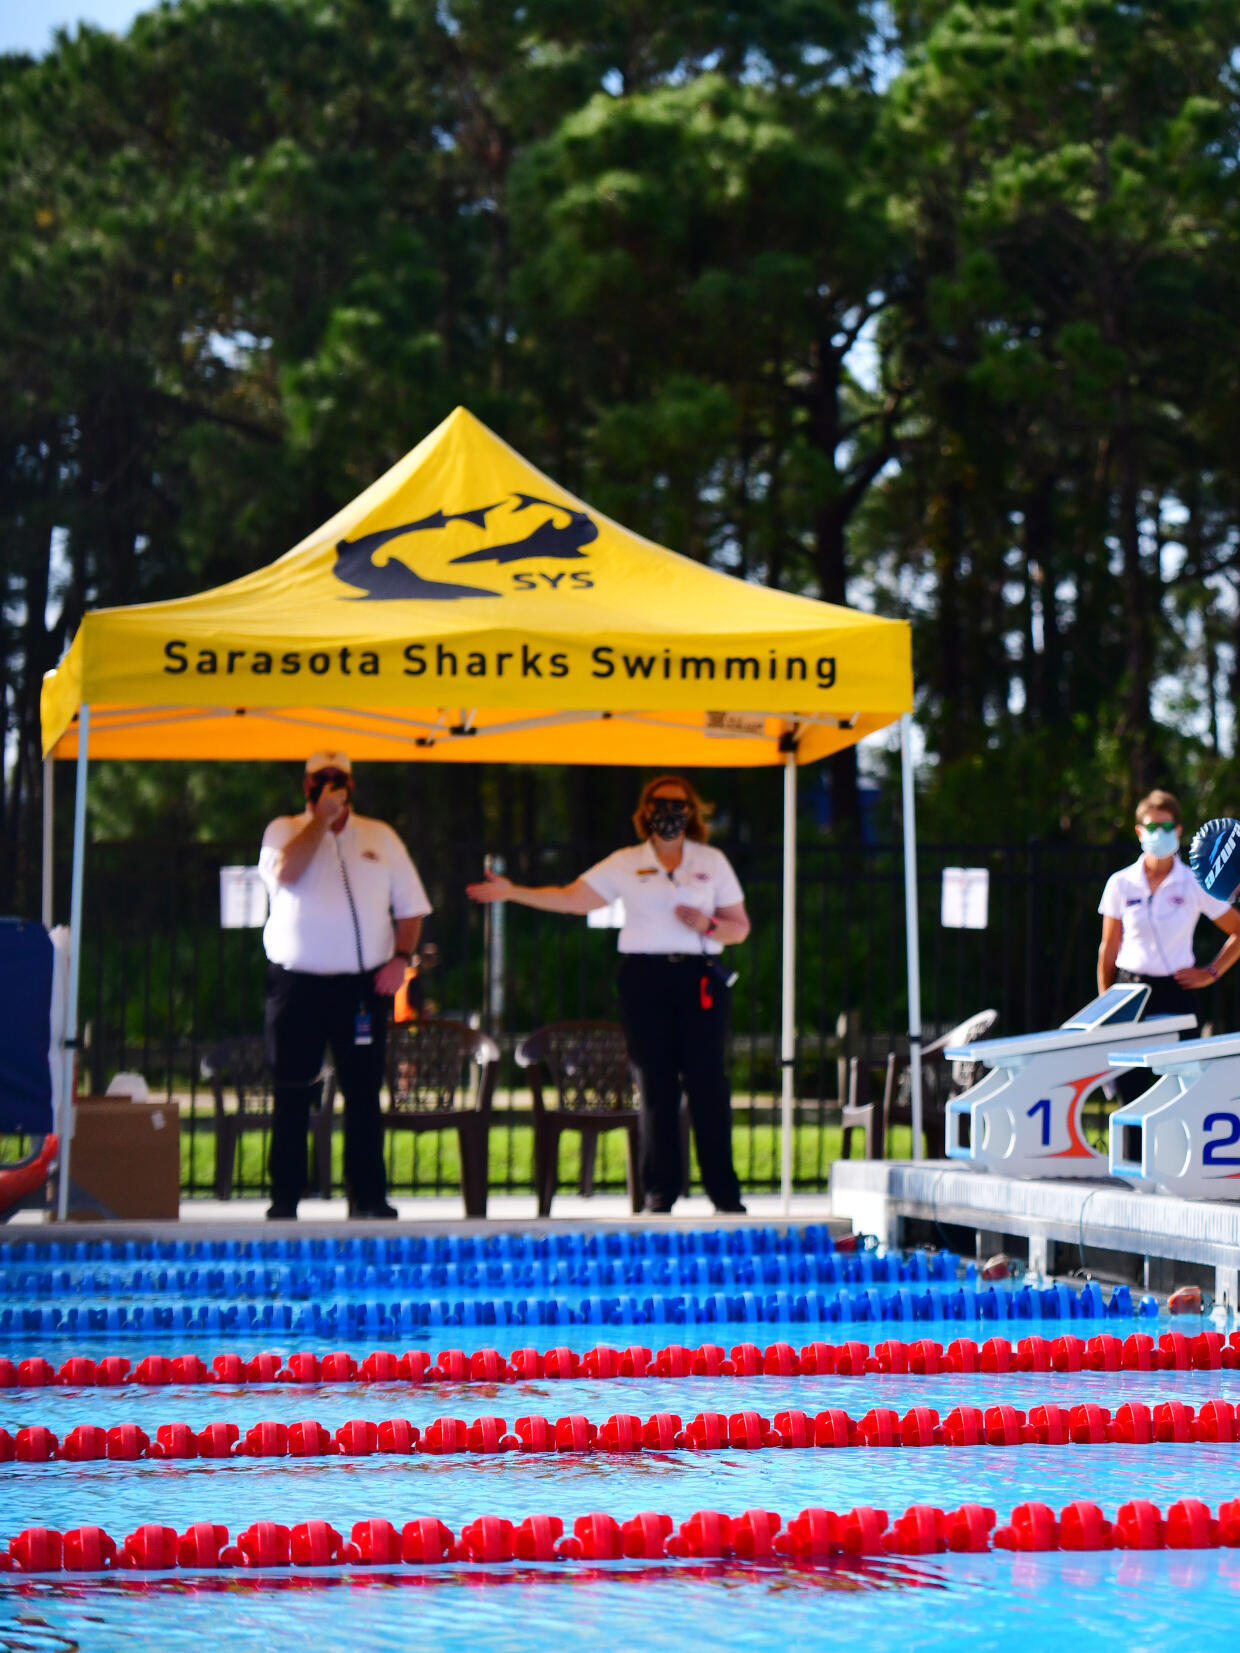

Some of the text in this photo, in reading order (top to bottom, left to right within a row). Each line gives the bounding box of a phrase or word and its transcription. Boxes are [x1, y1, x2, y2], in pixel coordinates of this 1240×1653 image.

[512, 571, 595, 590] SYS
[163, 640, 837, 690] Sarasota Sharks Swimming
[1026, 1099, 1052, 1146] 1
